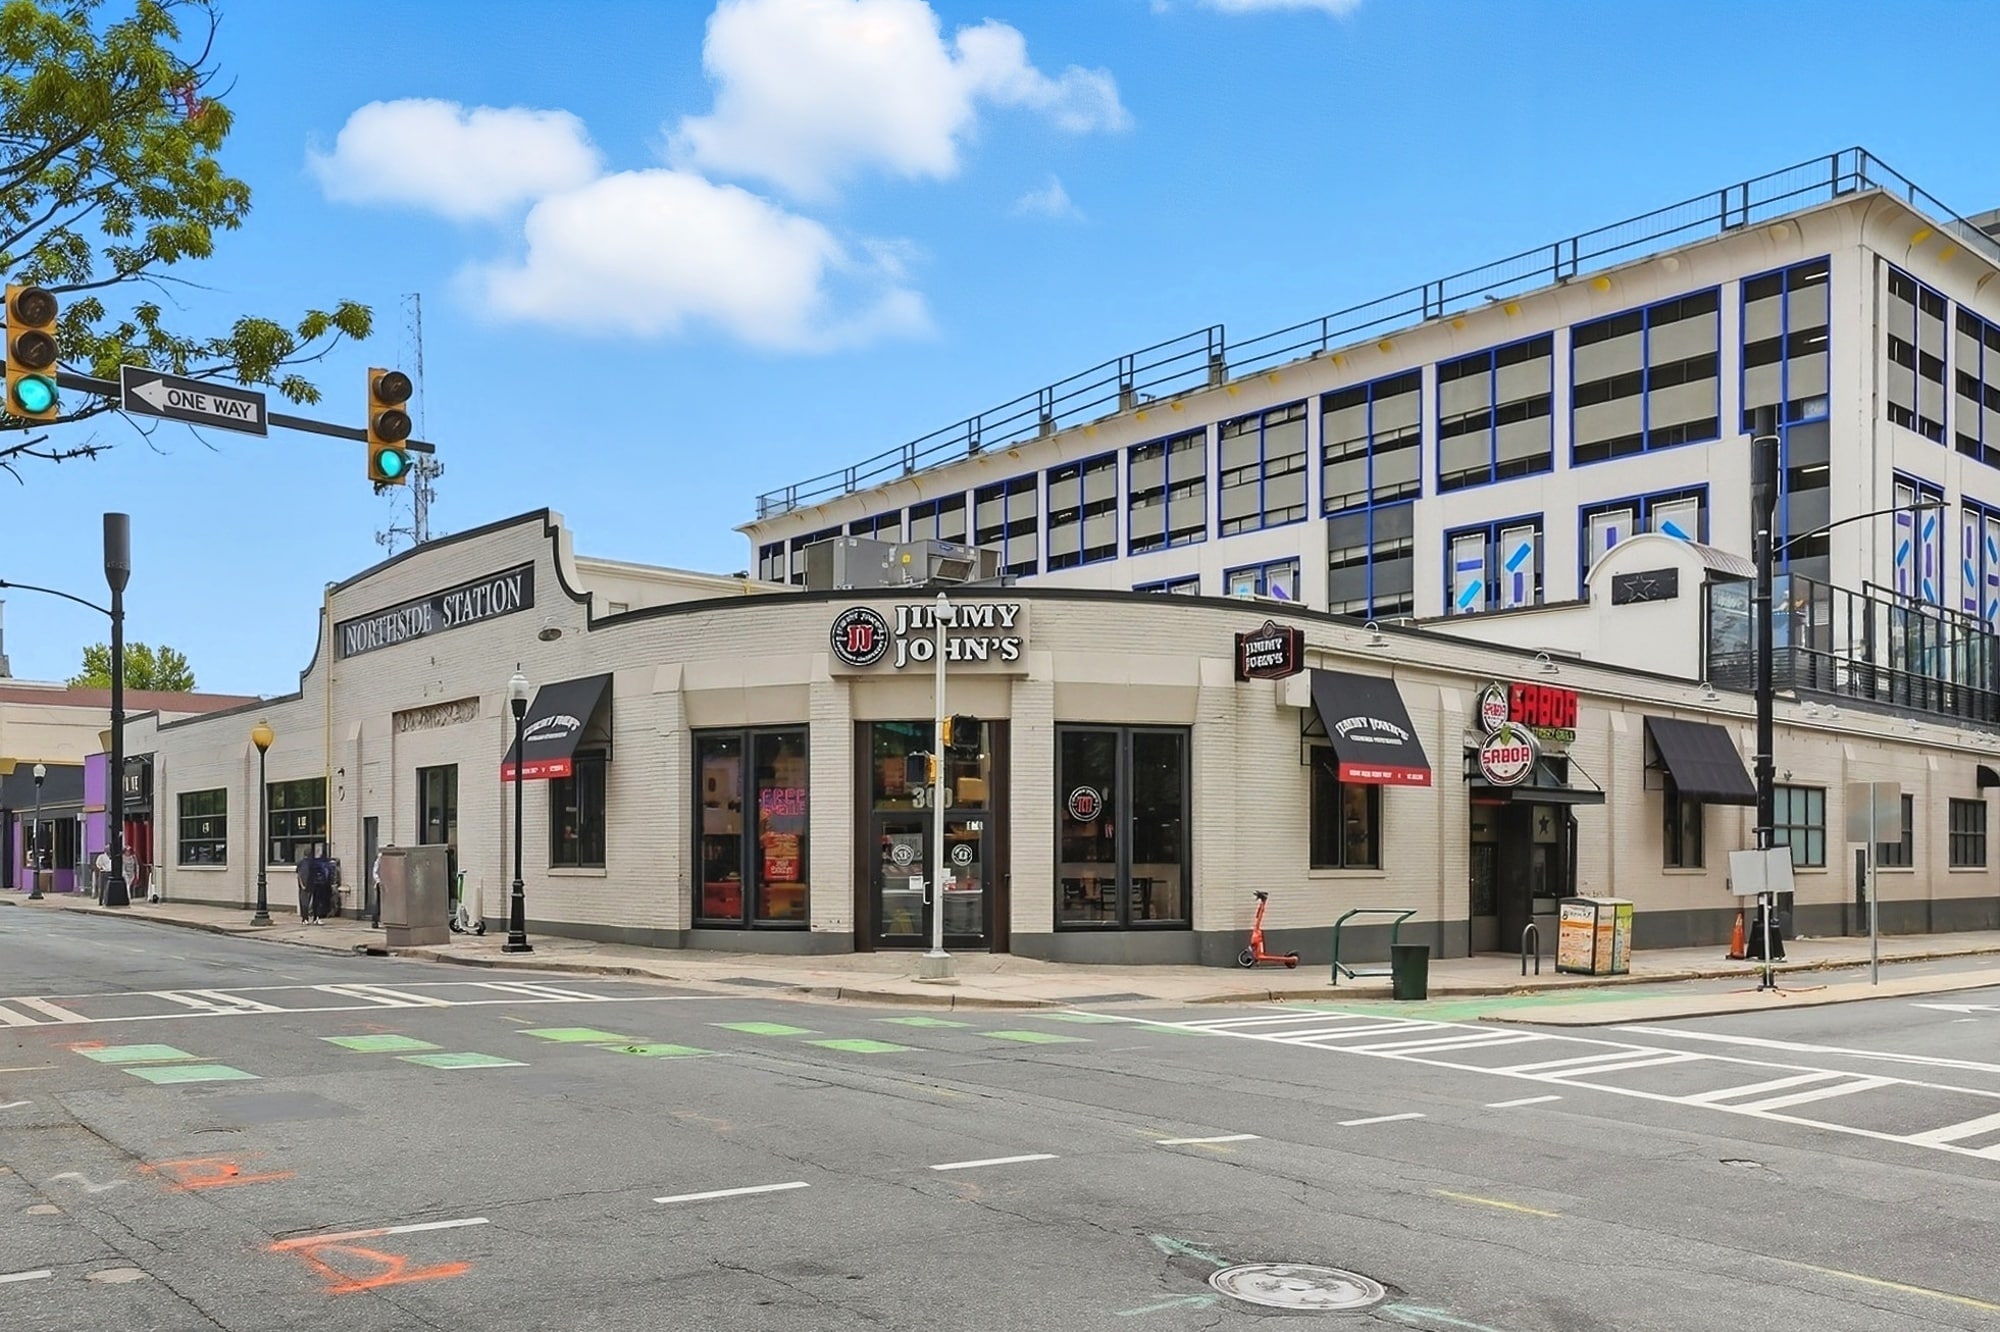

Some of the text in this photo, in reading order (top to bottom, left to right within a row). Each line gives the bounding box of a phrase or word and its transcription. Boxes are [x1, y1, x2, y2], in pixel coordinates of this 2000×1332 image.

[167, 389, 251, 419] ONE WAY
[346, 575, 522, 656] NORTHSIDE STATION
[895, 604, 1021, 636] JIMMY
[895, 637, 1020, 668] JOHN'S
